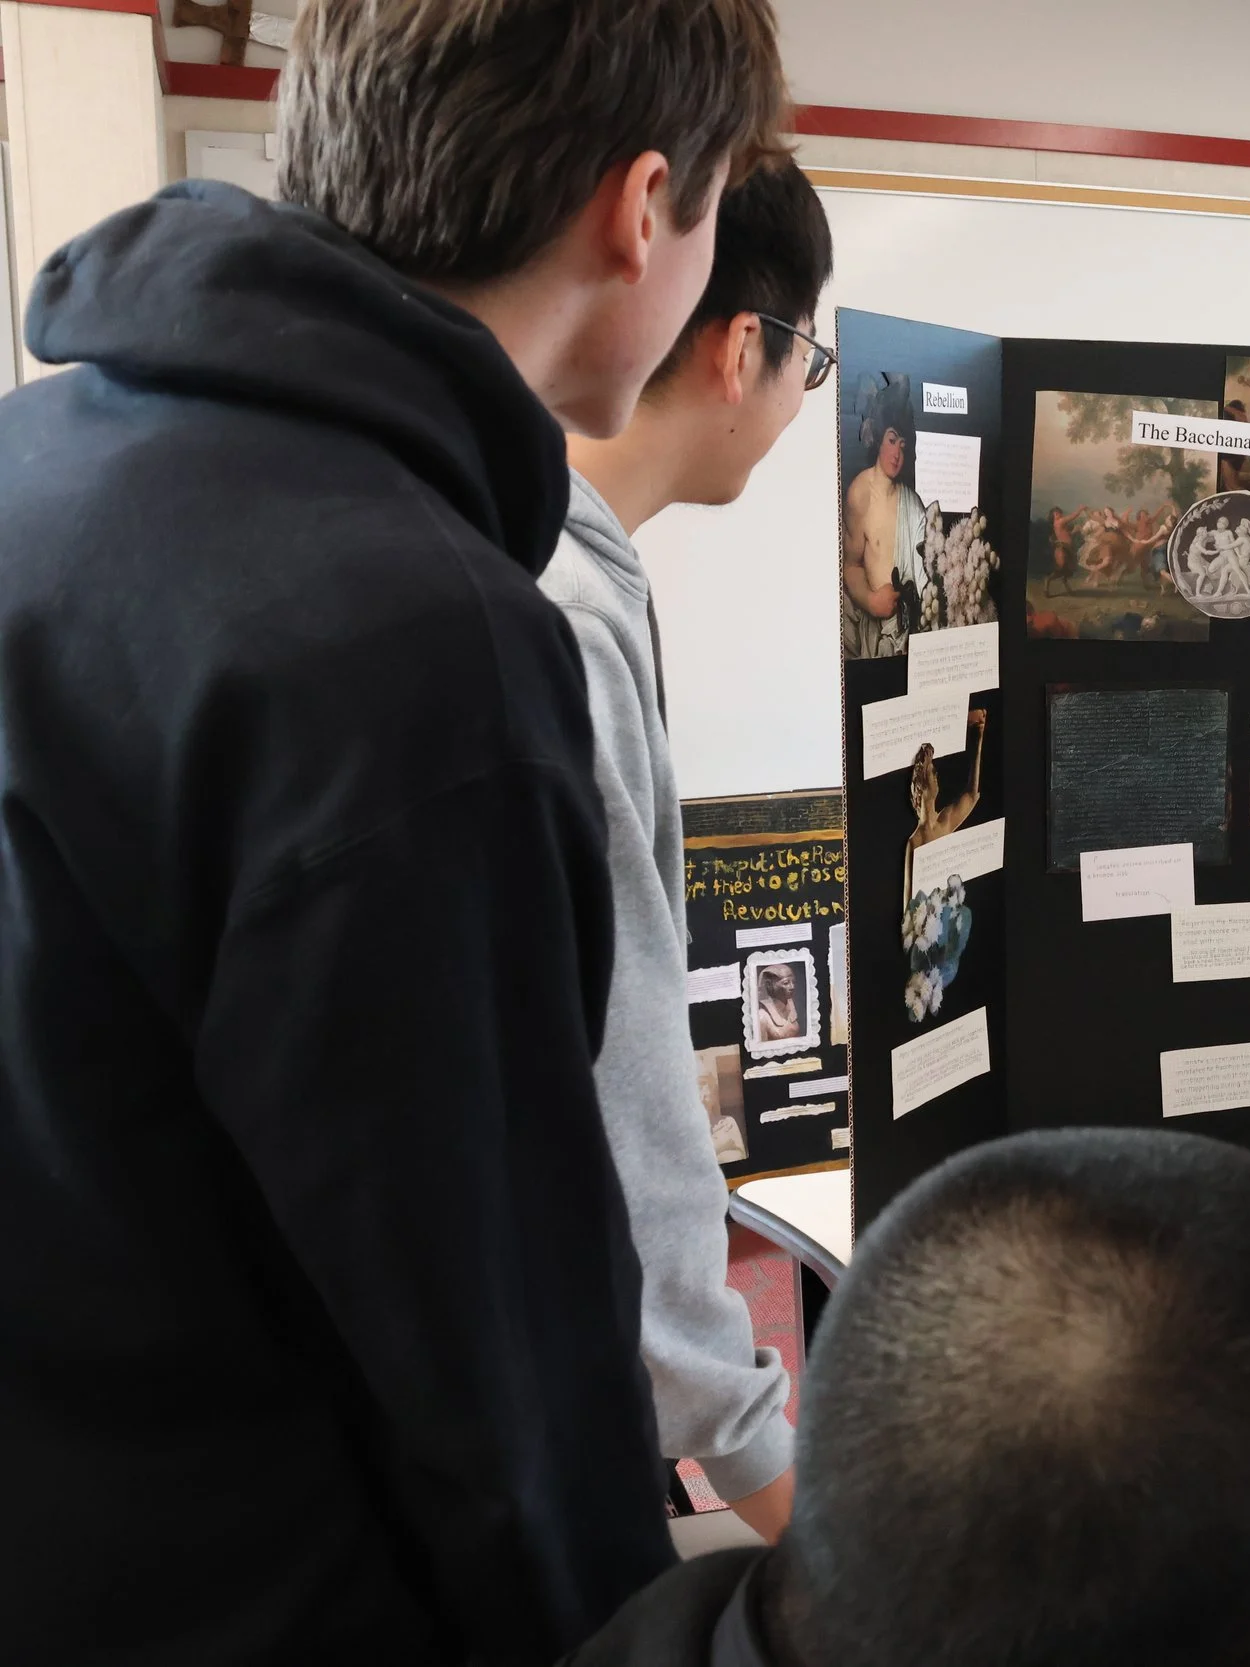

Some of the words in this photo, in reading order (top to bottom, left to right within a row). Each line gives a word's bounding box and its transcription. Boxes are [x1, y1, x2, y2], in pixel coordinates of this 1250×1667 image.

[926, 391, 965, 409] Rebellion
[1138, 422, 1170, 441] The
[776, 848, 810, 867] The
[713, 875, 752, 897] tried
[756, 876, 782, 890] to
[724, 899, 844, 921] Revolution
